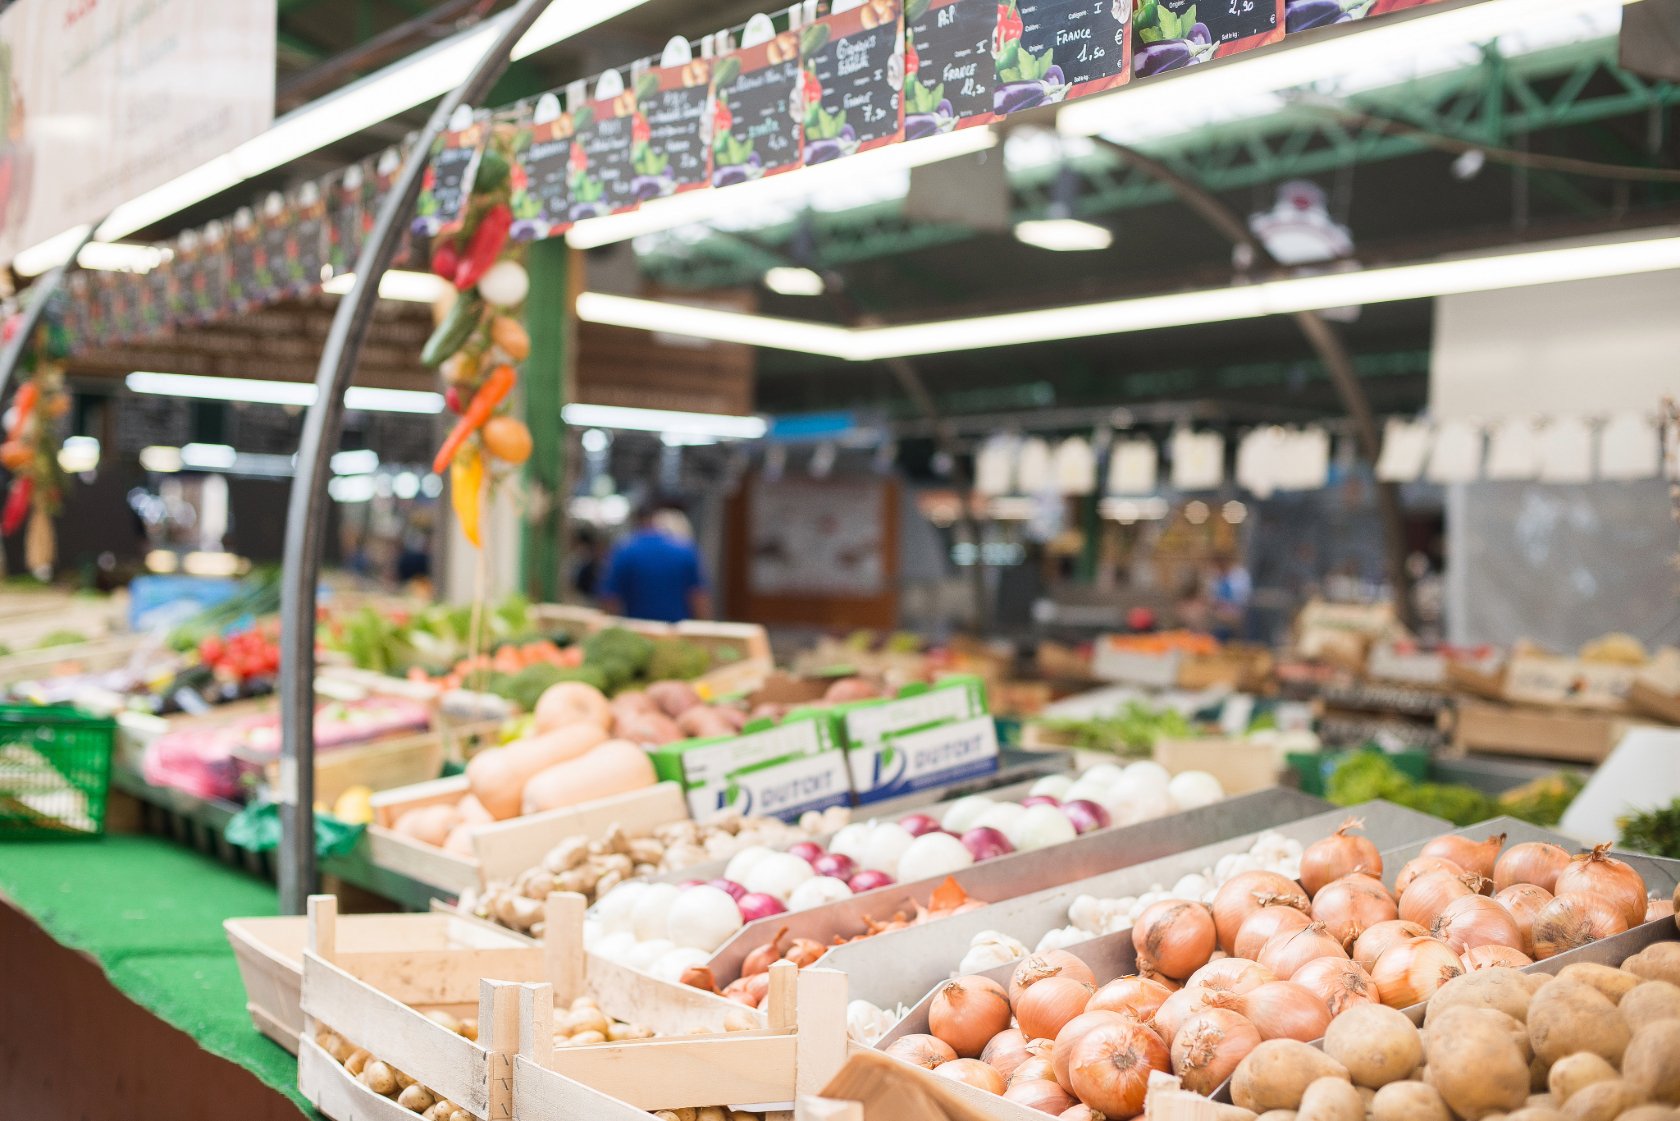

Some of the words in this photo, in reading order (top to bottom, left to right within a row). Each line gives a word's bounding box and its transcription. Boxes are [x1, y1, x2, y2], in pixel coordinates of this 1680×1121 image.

[1114, 28, 1124, 45] €
[1076, 43, 1106, 62] 1,50
[760, 769, 834, 808] DUTOIT
